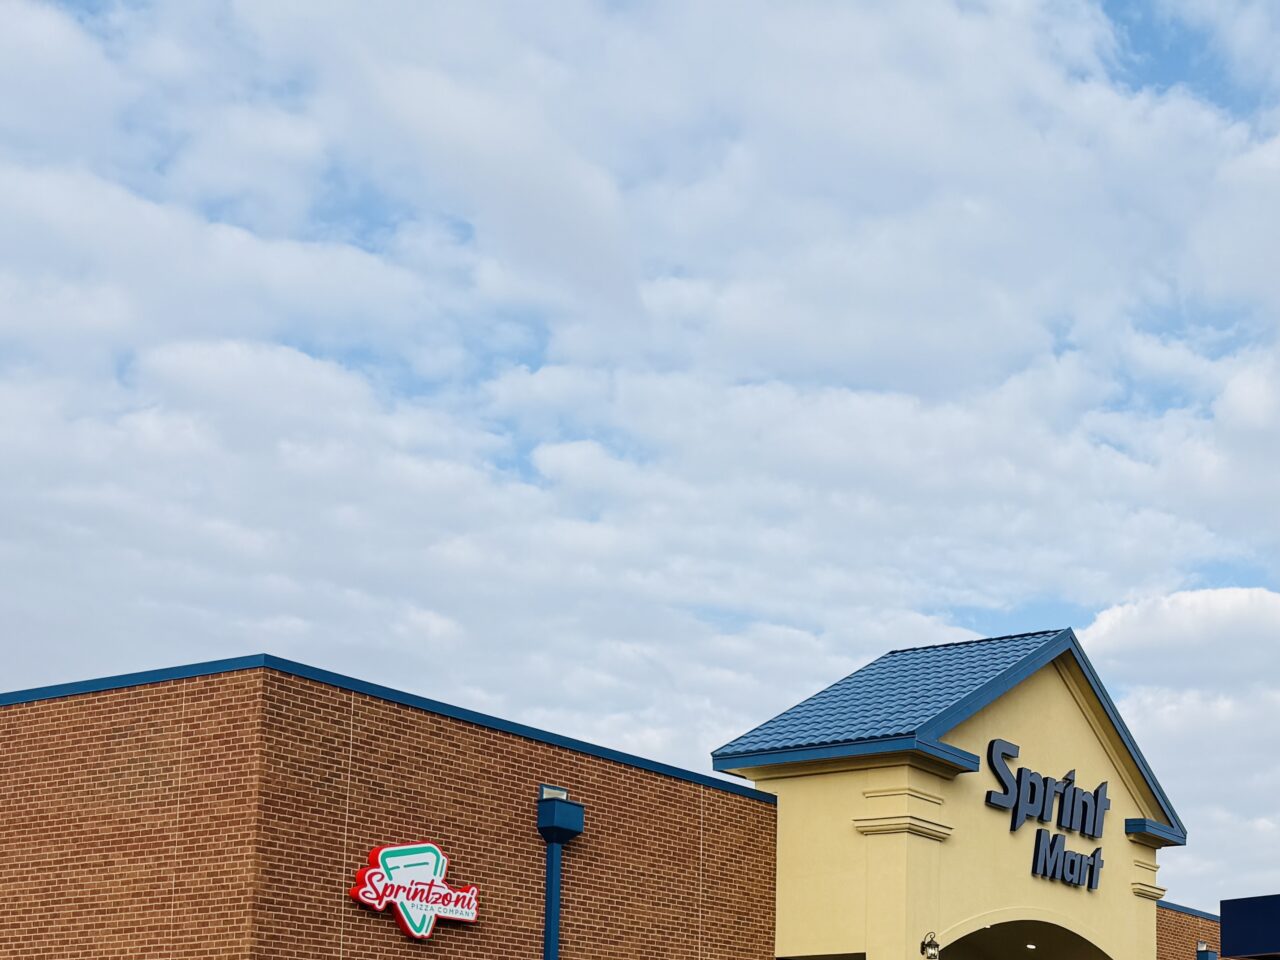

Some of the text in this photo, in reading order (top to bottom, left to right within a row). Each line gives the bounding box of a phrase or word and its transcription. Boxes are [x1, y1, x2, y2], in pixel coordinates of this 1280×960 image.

[985, 738, 1111, 839] Sprint
[1031, 828, 1105, 891] Mart
[361, 871, 476, 910] Sprintzoni
[410, 902, 475, 918] PIZZA COMPANY
